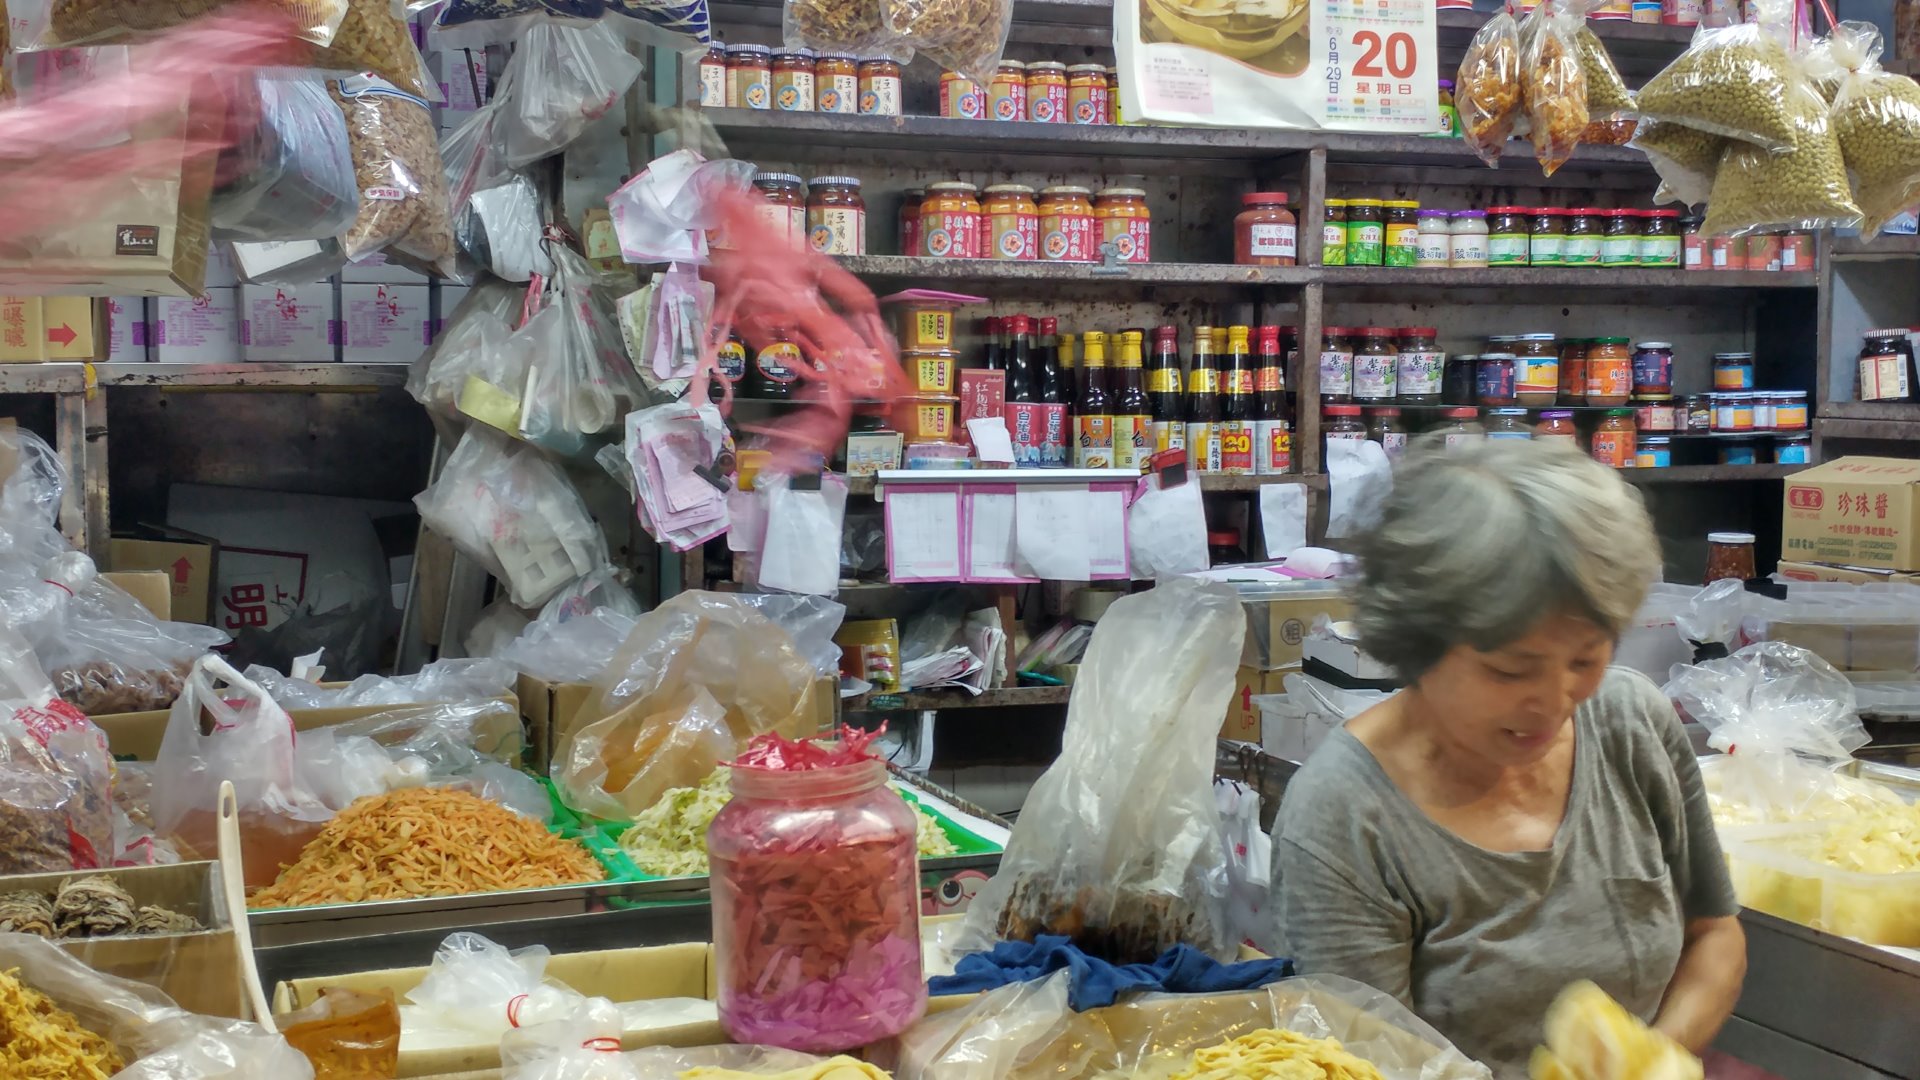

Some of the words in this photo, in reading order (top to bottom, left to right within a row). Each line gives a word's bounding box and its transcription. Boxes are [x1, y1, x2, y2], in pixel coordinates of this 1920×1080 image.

[1352, 30, 1417, 79] 20
[1356, 82, 1412, 95] 星期日
[1837, 491, 1889, 519] 珍珠醬
[223, 584, 268, 630] 明
[1241, 711, 1256, 730] UP
